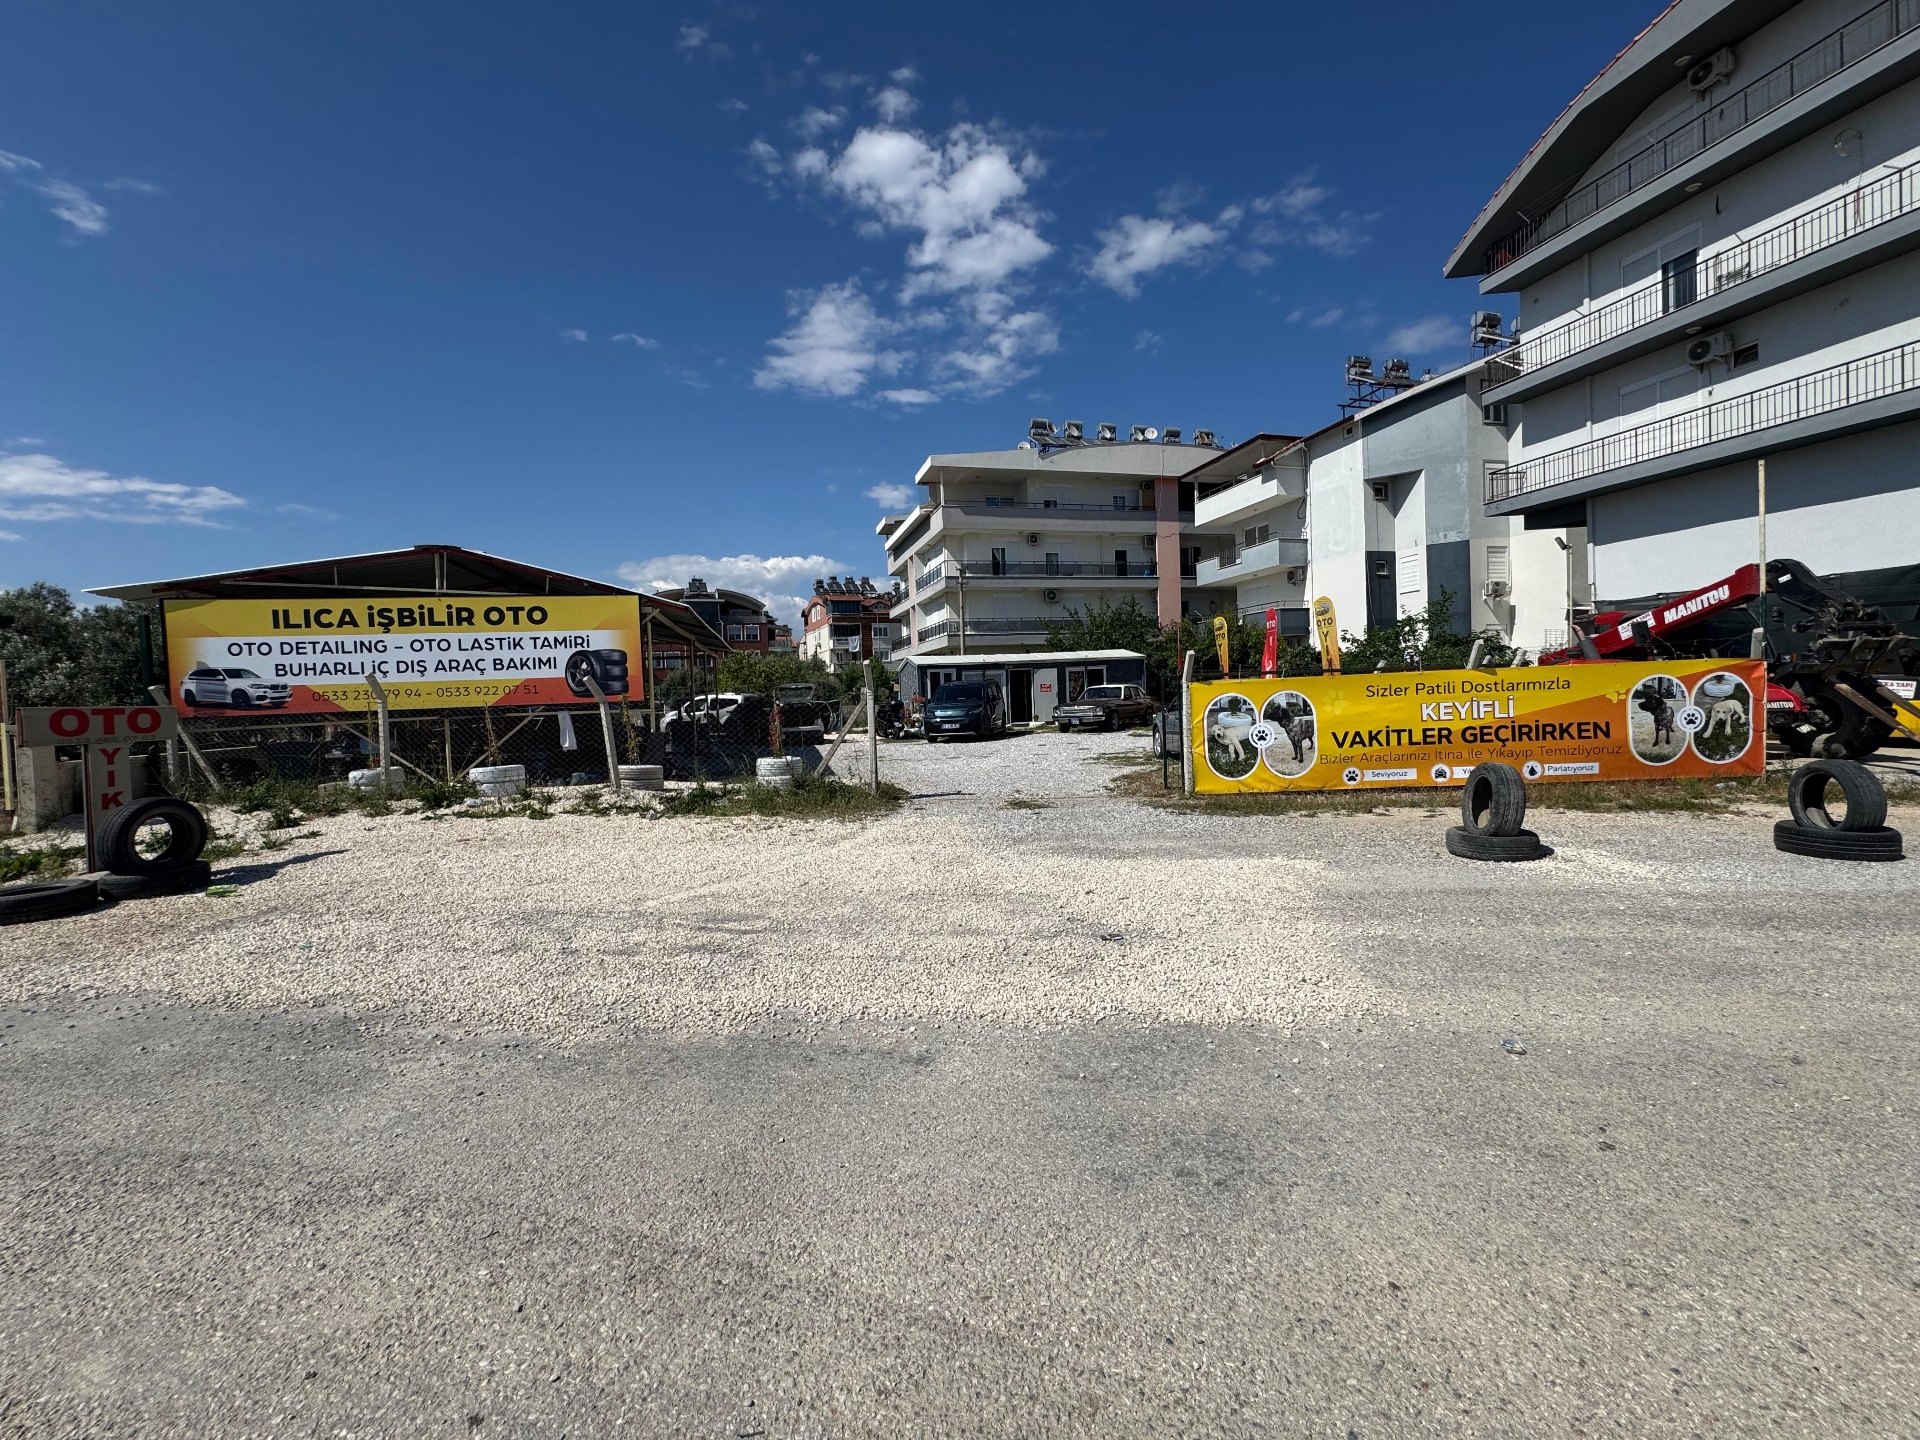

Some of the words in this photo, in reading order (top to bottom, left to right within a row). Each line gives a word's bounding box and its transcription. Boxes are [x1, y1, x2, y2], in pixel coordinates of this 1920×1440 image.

[1663, 584, 1730, 625] MANITOU
[271, 608, 360, 630] ILICA
[483, 605, 548, 626] OTO
[1316, 617, 1334, 628] OTO
[227, 641, 273, 657] OTO
[280, 639, 388, 656] DETAILING
[409, 637, 452, 653] OTO
[274, 661, 365, 677] BUHARLI
[396, 659, 428, 677] DIŞ
[434, 658, 486, 677] ARAÇ
[492, 656, 558, 672] BAKIMI
[312, 690, 348, 702] 0533
[383, 688, 400, 699] 79
[404, 688, 422, 698] 94
[436, 686, 470, 697] 0533
[475, 685, 499, 696] 922
[502, 684, 519, 696] 07
[523, 684, 540, 695] 51
[1365, 683, 1410, 698] Sizler
[1415, 681, 1455, 696] Patili
[1461, 676, 1571, 694] Dostlarımızla
[1420, 695, 1515, 722] KEYİFLİ
[1766, 701, 1794, 709] ANITOU
[49, 707, 162, 737] OTO
[1330, 725, 1453, 749] VAKİTLER
[1460, 720, 1611, 748] GEÇİRİRKEN
[1319, 753, 1356, 765] Bizler
[1359, 751, 1431, 765] Araçlarınızı
[1468, 748, 1483, 759] ile
[1487, 747, 1533, 762] Yıkayıp
[1537, 744, 1623, 759] Temizliyoruz
[1371, 770, 1408, 779] Seviyoruz
[1547, 764, 1595, 774] Parlatıyoruz
